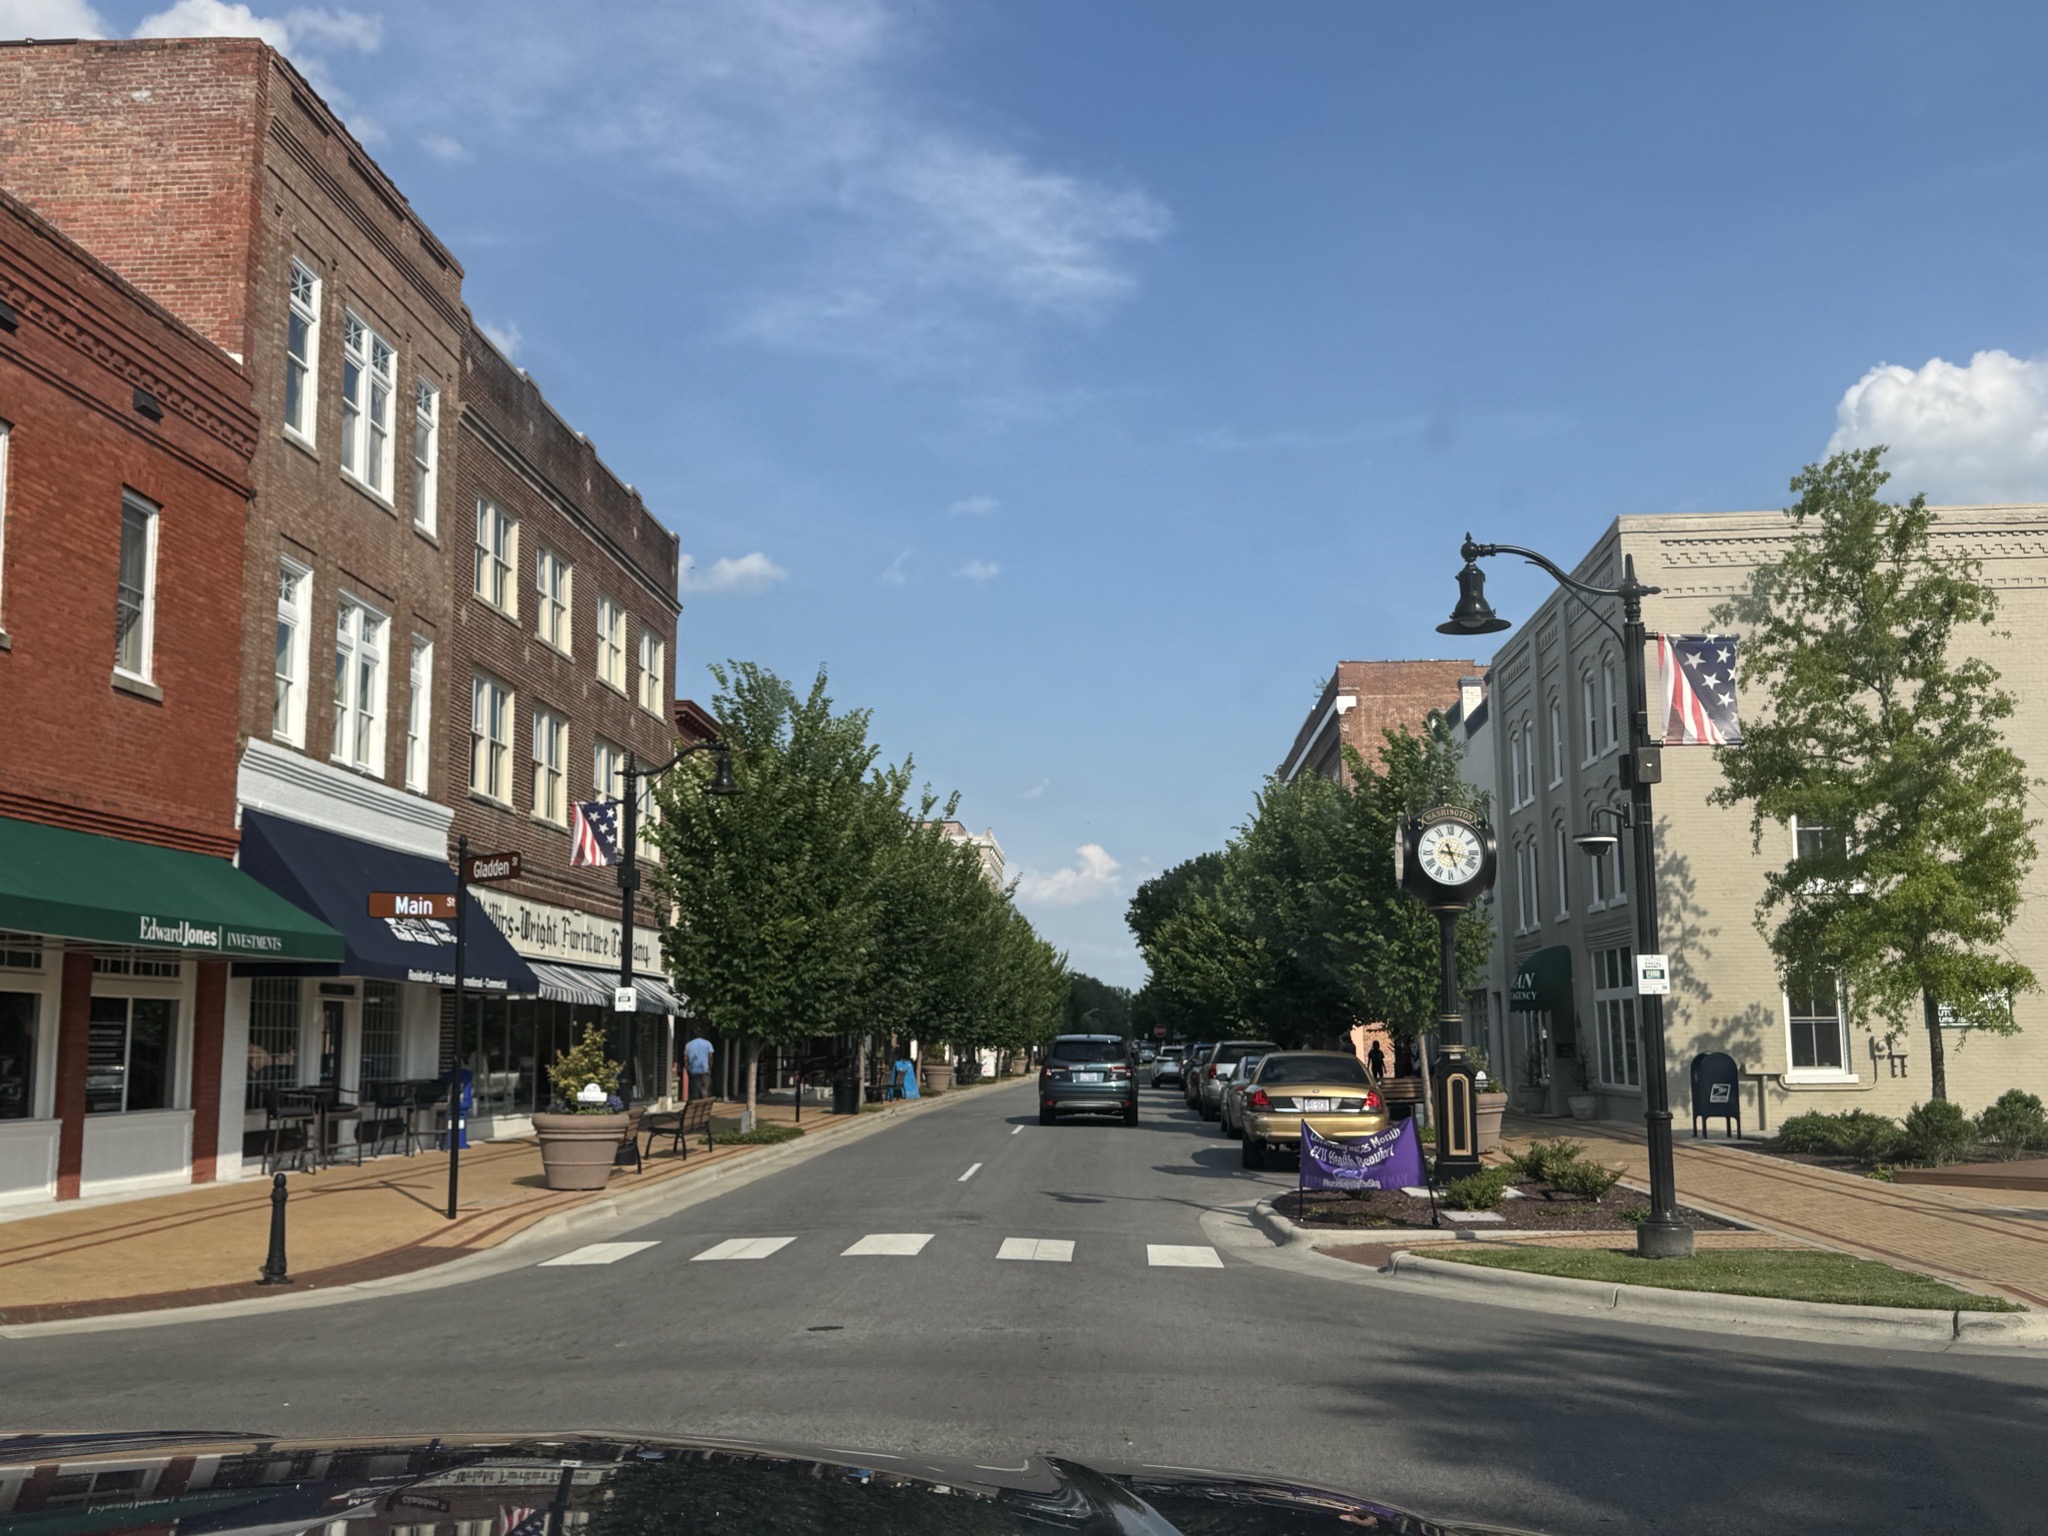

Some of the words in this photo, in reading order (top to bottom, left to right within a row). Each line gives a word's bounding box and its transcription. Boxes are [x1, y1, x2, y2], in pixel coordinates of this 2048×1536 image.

[1425, 808, 1474, 821] WASHINGTON
[473, 860, 510, 879] Gladden
[511, 857, 519, 867] St
[394, 895, 434, 916] Main
[446, 896, 457, 908] St
[226, 931, 283, 951] INVESTMENTS
[1369, 1127, 1401, 1147] Month
[1328, 1149, 1355, 1167] Health
[1355, 1143, 1395, 1168] Beaufort
